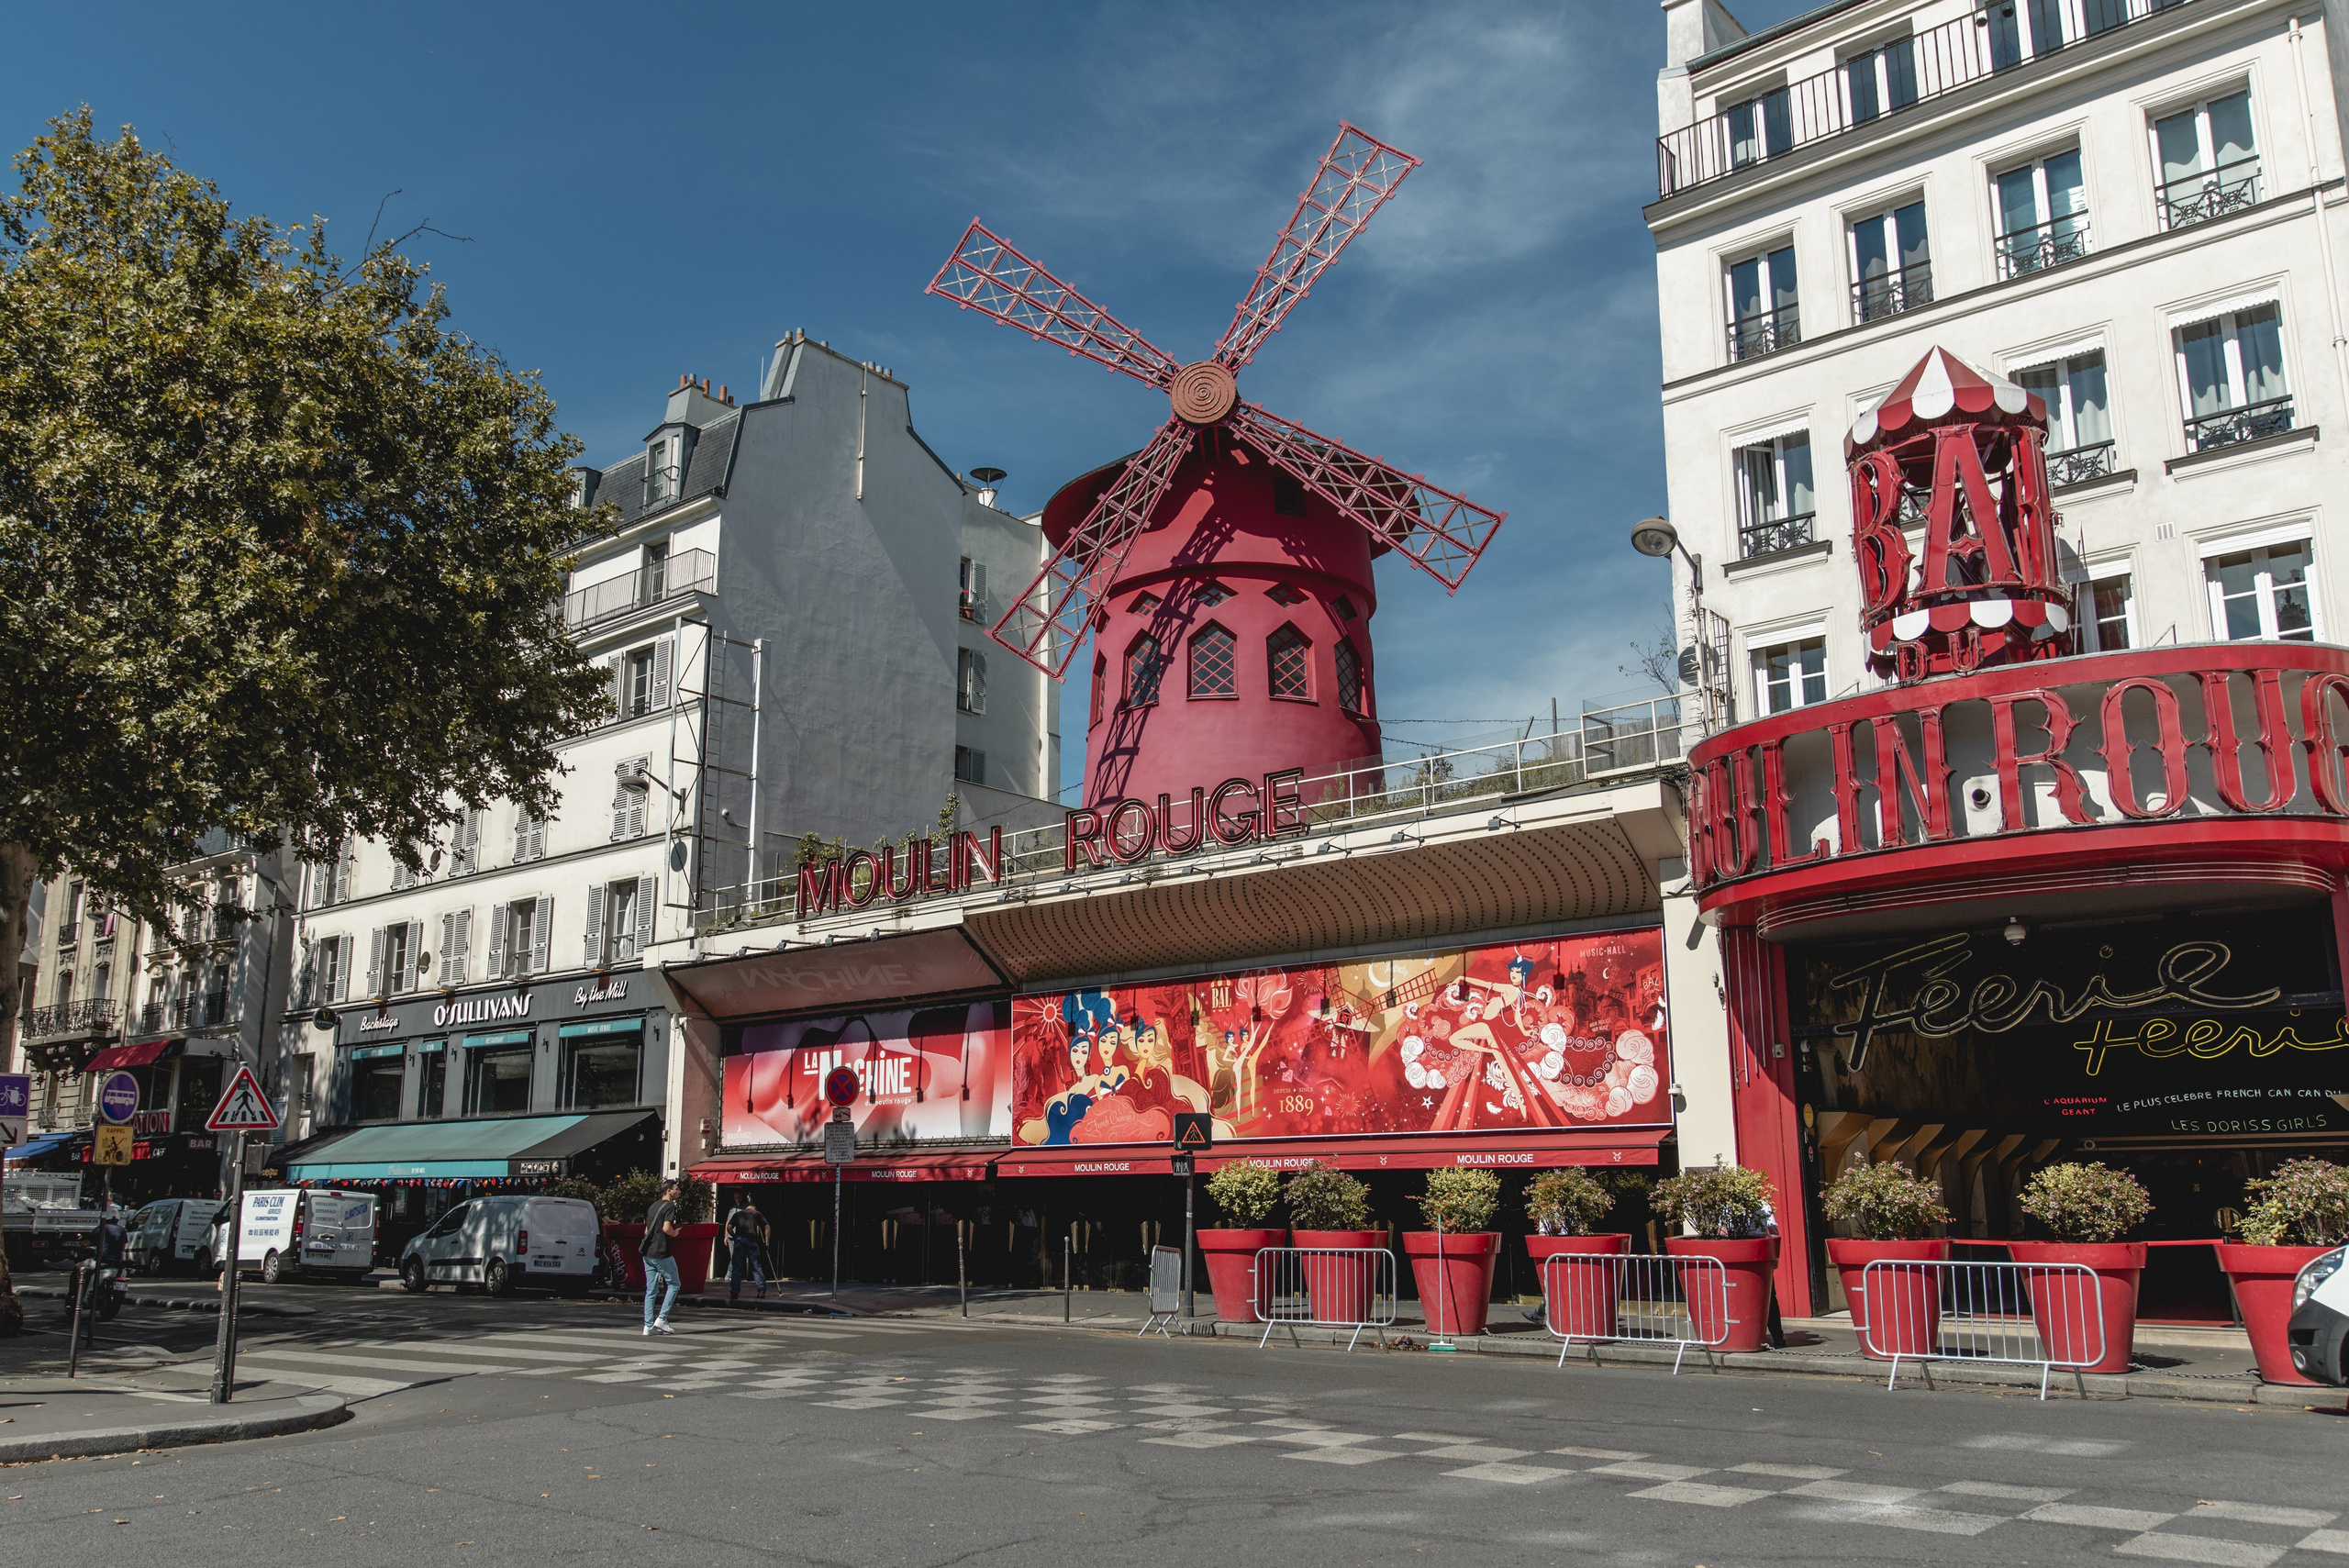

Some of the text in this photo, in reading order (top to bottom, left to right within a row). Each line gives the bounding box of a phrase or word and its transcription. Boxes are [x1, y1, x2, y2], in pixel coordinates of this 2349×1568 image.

[796, 766, 1306, 917] MOULIN ROUGE
[1579, 945, 1626, 958] MUSIC-HALL
[1642, 976, 1659, 990] BAL
[574, 980, 629, 1008] By the Mill
[1211, 986, 1232, 1009] BAL
[433, 993, 534, 1028] O'SULLIVANS
[360, 1013, 399, 1033] Backstage
[587, 1024, 612, 1033] MUSIC VENUE
[485, 1036, 505, 1044] RESTAURANT
[804, 1051, 818, 1070] LA
[818, 1050, 912, 1100] MCHiNE
[894, 1097, 912, 1106] rouge
[1279, 1095, 1314, 1117] 1889
[2117, 1103, 2131, 1113] LE
[2133, 1097, 2162, 1109] PLUS
[2164, 1091, 2212, 1104] CELEBRE
[2217, 1088, 2261, 1098] FRENCH
[2267, 1088, 2291, 1097] CAN
[2298, 1089, 2321, 1097] CAN
[2061, 1107, 2096, 1116] GEANT
[2171, 1119, 2200, 1131] LES
[2207, 1119, 2271, 1132] DORISS
[189, 1139, 212, 1148] BAR
[72, 1152, 81, 1161] BAR
[1457, 1153, 1534, 1164] MOULIN ROUGE
[1074, 1162, 1130, 1172] MOULIN ROUGE
[740, 1172, 779, 1180] MOULIN ROUGE
[872, 1170, 918, 1178] MOULIN ROUGE
[252, 1196, 285, 1207] PARIS CLIM
